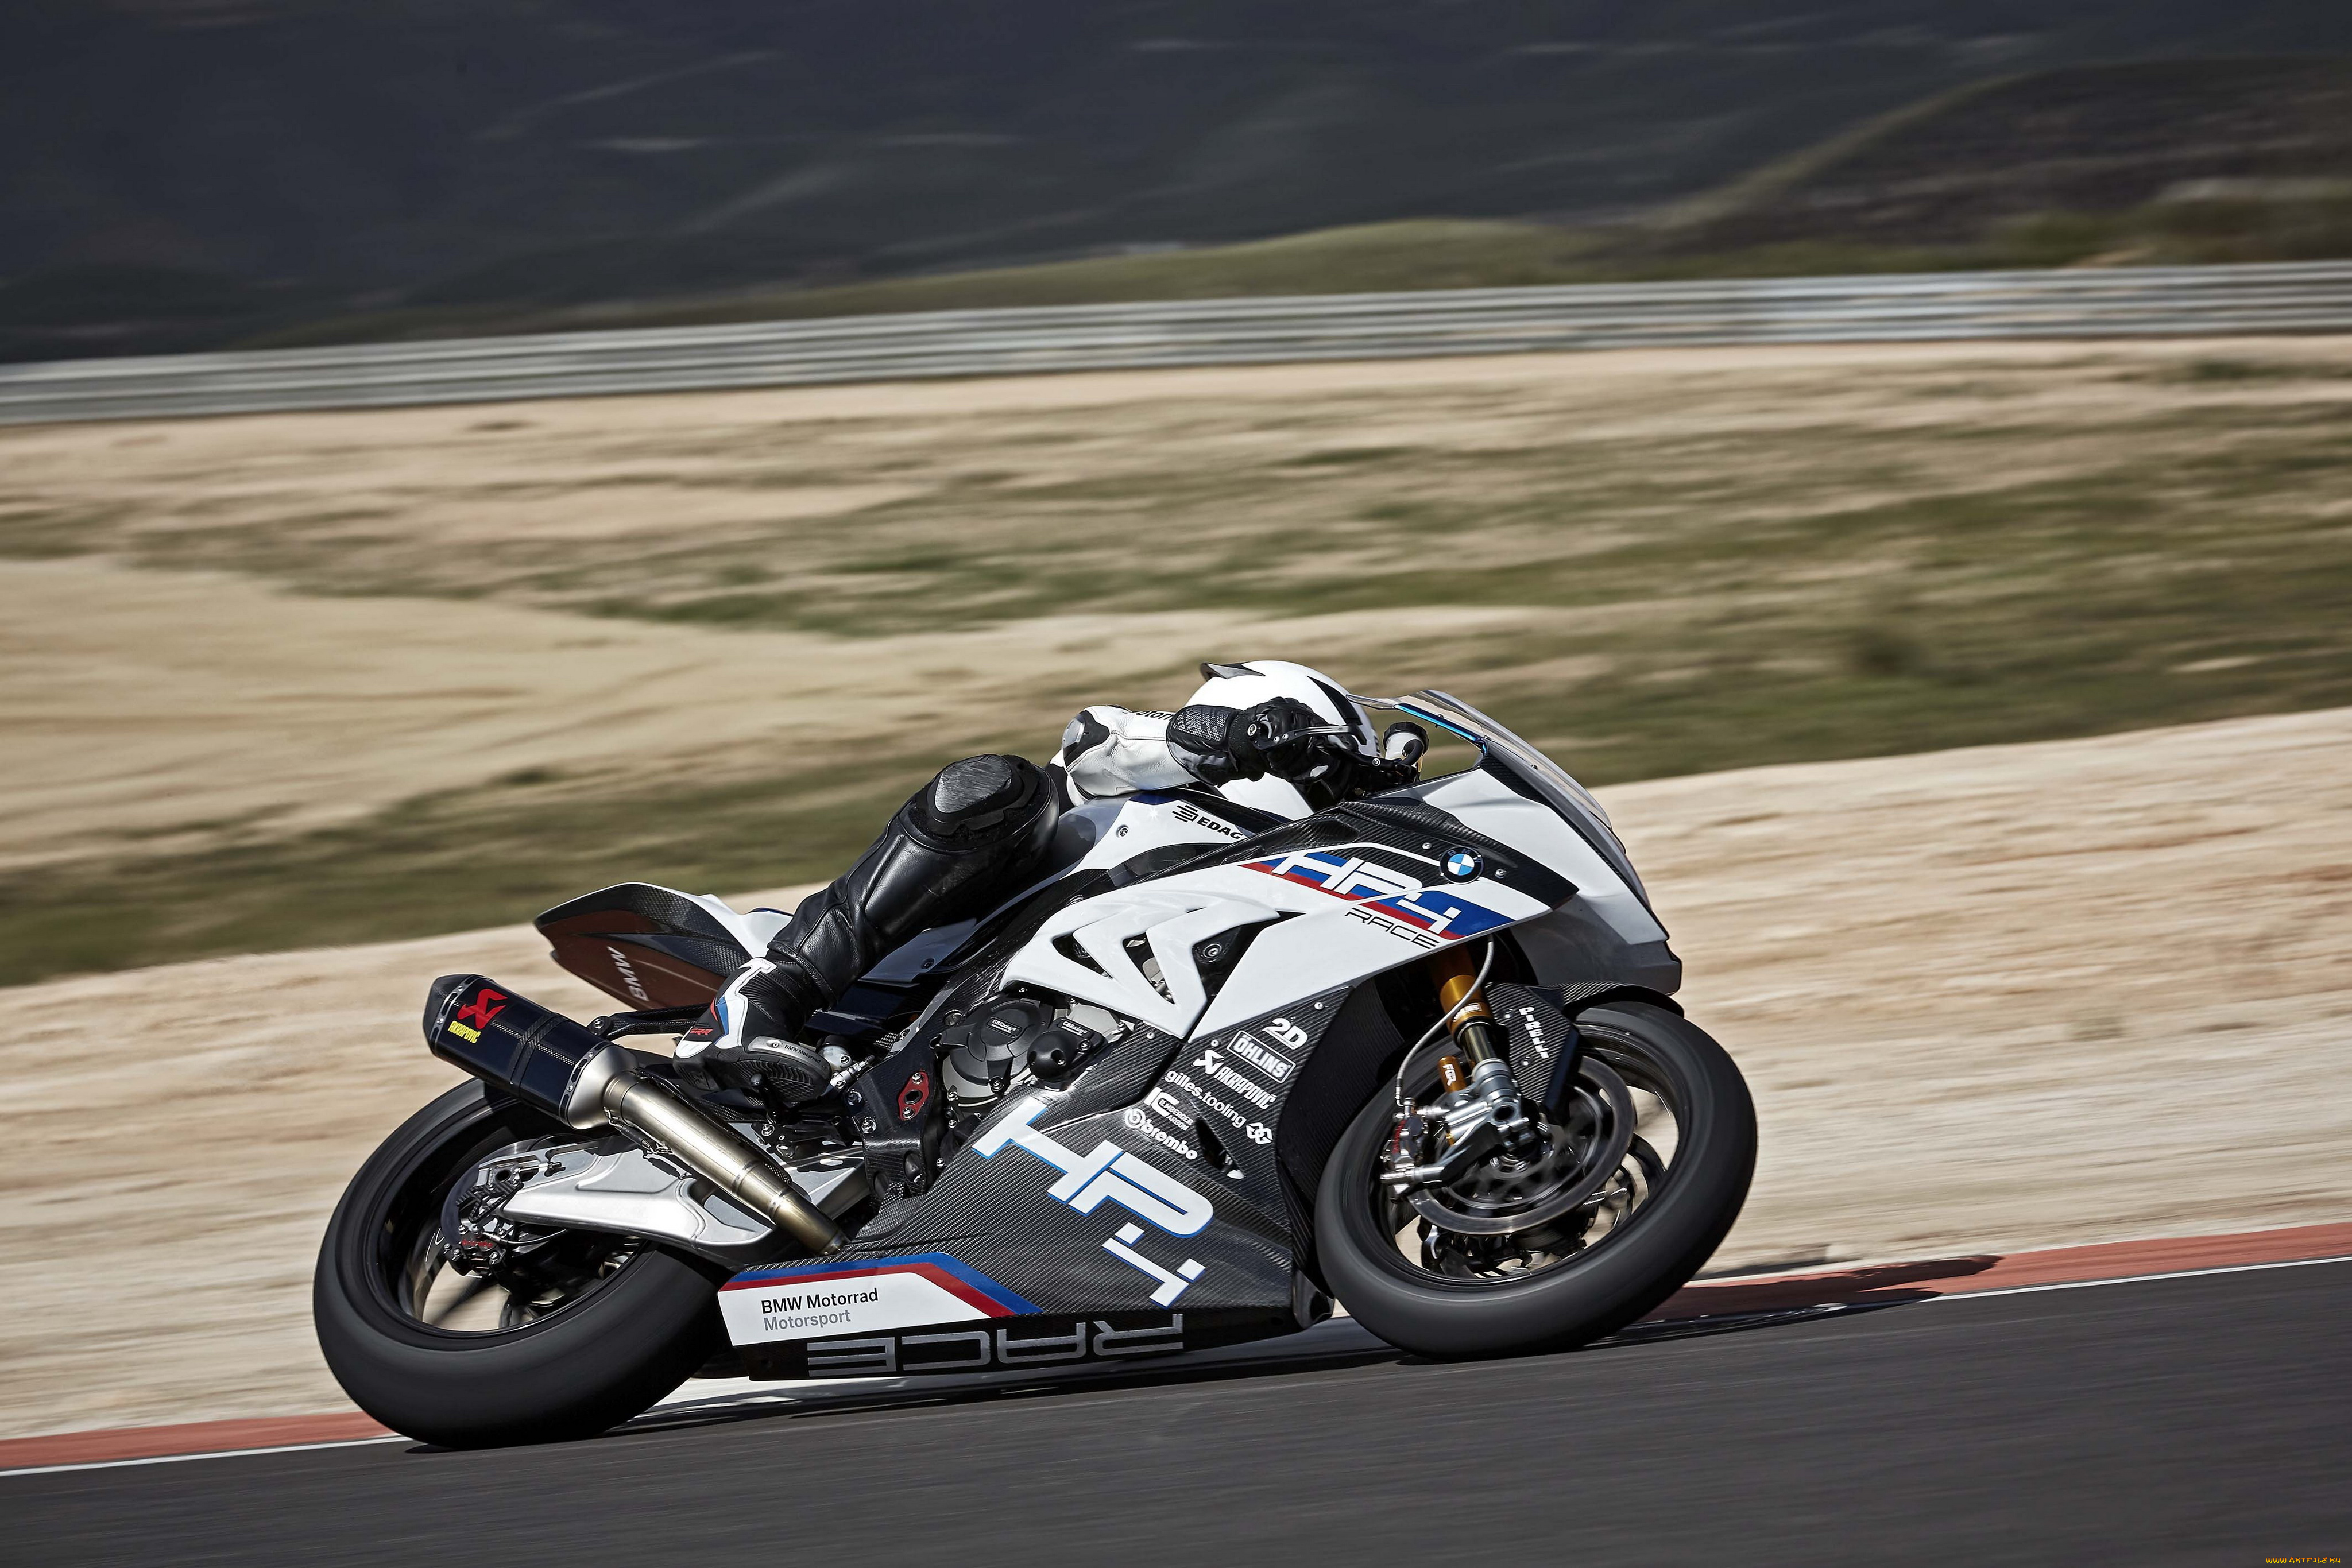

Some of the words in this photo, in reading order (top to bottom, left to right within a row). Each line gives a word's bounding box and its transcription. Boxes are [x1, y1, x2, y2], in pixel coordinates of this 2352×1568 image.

[1197, 816, 1243, 839] EDAG
[1271, 855, 1462, 935] HP4
[1345, 907, 1440, 950] RACE
[606, 946, 650, 1001] BMW
[784, 1044, 799, 1052] BMW
[798, 1049, 821, 1064] Motorrad
[1262, 1017, 1308, 1050] 2D
[1519, 1006, 1549, 1059] PIRELLI
[1233, 1034, 1289, 1078] ÖHLINS
[1163, 1070, 1247, 1128] gilles.tooling
[1140, 1118, 1198, 1160] brembo
[972, 1096, 1214, 1309] HP4
[761, 1296, 802, 1314] BMW
[806, 1287, 879, 1309] Motorrad
[764, 1310, 852, 1331] Motorsport
[807, 1313, 1184, 1377] RACE
